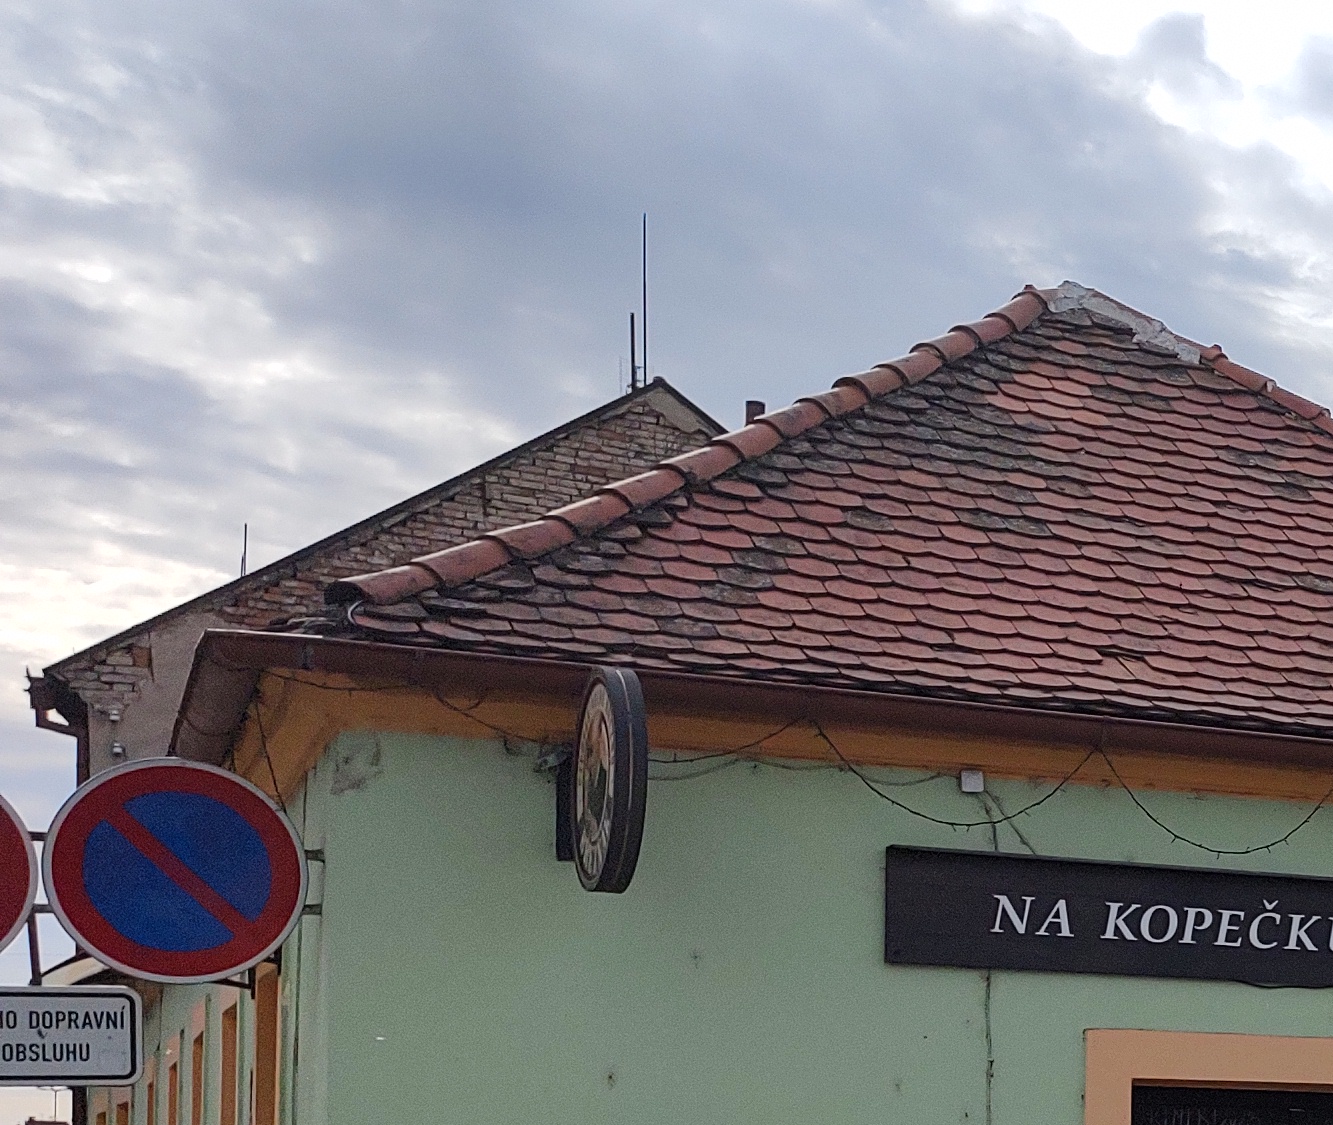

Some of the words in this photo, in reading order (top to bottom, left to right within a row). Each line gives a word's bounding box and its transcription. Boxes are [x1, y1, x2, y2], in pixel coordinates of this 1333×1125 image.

[990, 895, 1075, 938] NA
[29, 1005, 126, 1030] DOPRAVNÍ
[2, 1043, 91, 1062] OBSLUHU
